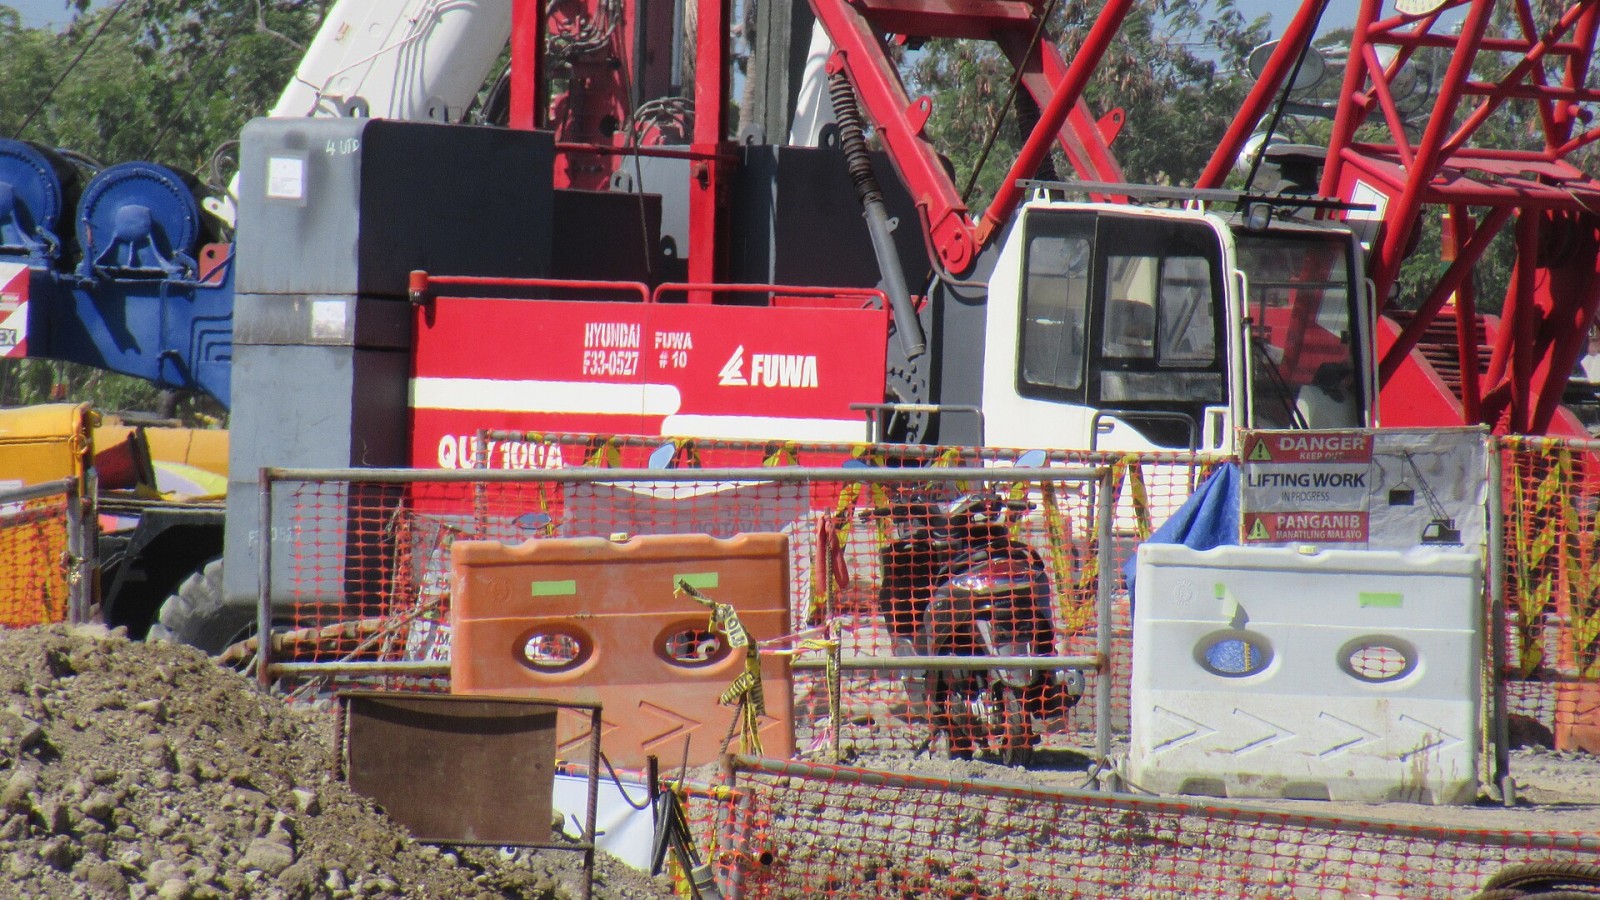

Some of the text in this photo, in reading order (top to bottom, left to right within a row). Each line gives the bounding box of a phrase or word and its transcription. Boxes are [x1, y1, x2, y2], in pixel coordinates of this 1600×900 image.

[584, 322, 641, 349] HYUNDAI
[654, 331, 693, 350] FUWA
[582, 350, 639, 376] F33-0527
[671, 350, 688, 369] 10
[750, 353, 818, 388] FUWA
[1279, 437, 1365, 451] DANGER
[1299, 452, 1322, 460] KEEP
[1248, 473, 1366, 488] LIFTING WORK
[1282, 492, 1330, 502] IN PROGRESS
[1277, 514, 1361, 529] PANGANIB
[1275, 530, 1362, 540] MANATILING MALAYO
